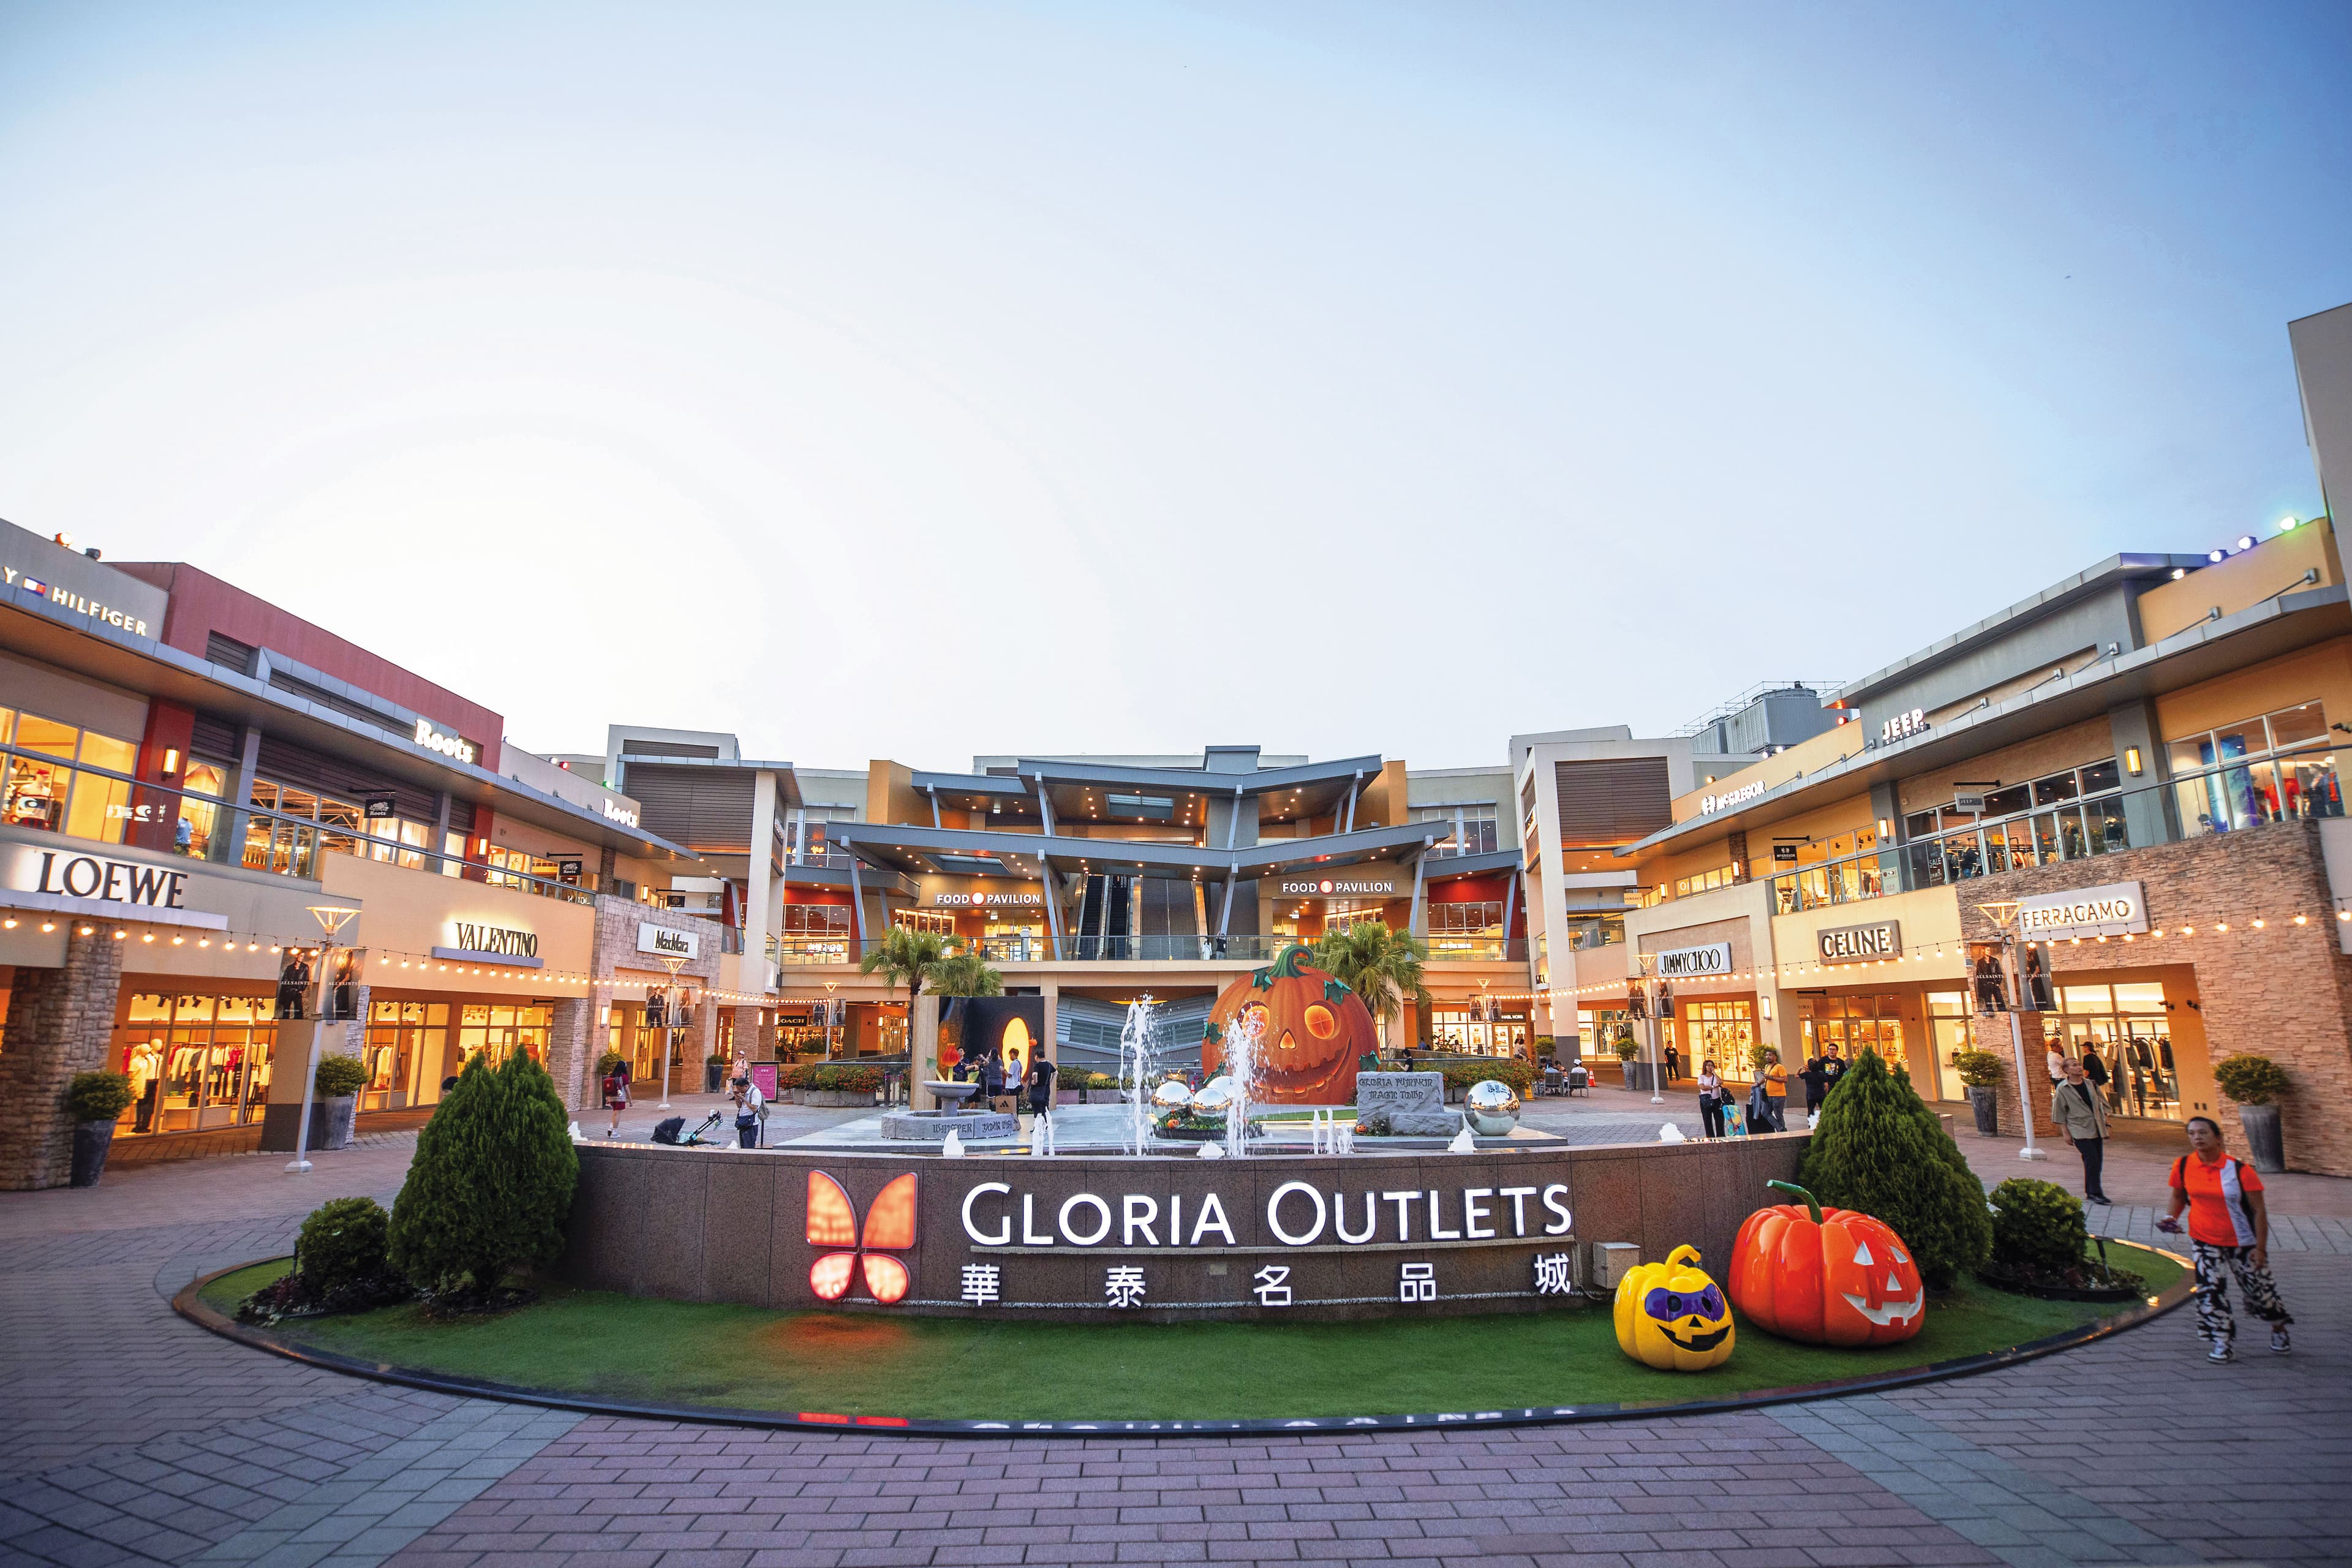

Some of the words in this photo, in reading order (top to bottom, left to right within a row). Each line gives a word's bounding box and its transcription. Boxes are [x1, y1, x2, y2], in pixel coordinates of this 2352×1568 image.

[51, 586, 147, 636] HILFIGER
[413, 718, 473, 764] Roots
[603, 798, 638, 829] Roots
[1929, 857, 1942, 867] SALE
[35, 852, 188, 910] LOEWE
[1282, 882, 1317, 893] FOOD
[1335, 882, 1393, 892] PAVILION
[937, 894, 970, 904] FOOD
[987, 894, 1041, 904] PAVILION
[2022, 900, 2130, 928] FERRAGAMO
[455, 922, 538, 958] VALENTINO
[1821, 928, 1890, 957] CELINE
[1359, 1077, 1392, 1087] GLORIA
[1368, 1090, 1397, 1100] MAGIC
[1400, 1090, 1424, 1099] TOWN
[982, 1120, 1001, 1133] YOUR
[961, 1182, 1236, 1246] GLORIA
[1267, 1180, 1572, 1246] OUTLETS
[960, 1253, 1572, 1308] 華泰名品城
